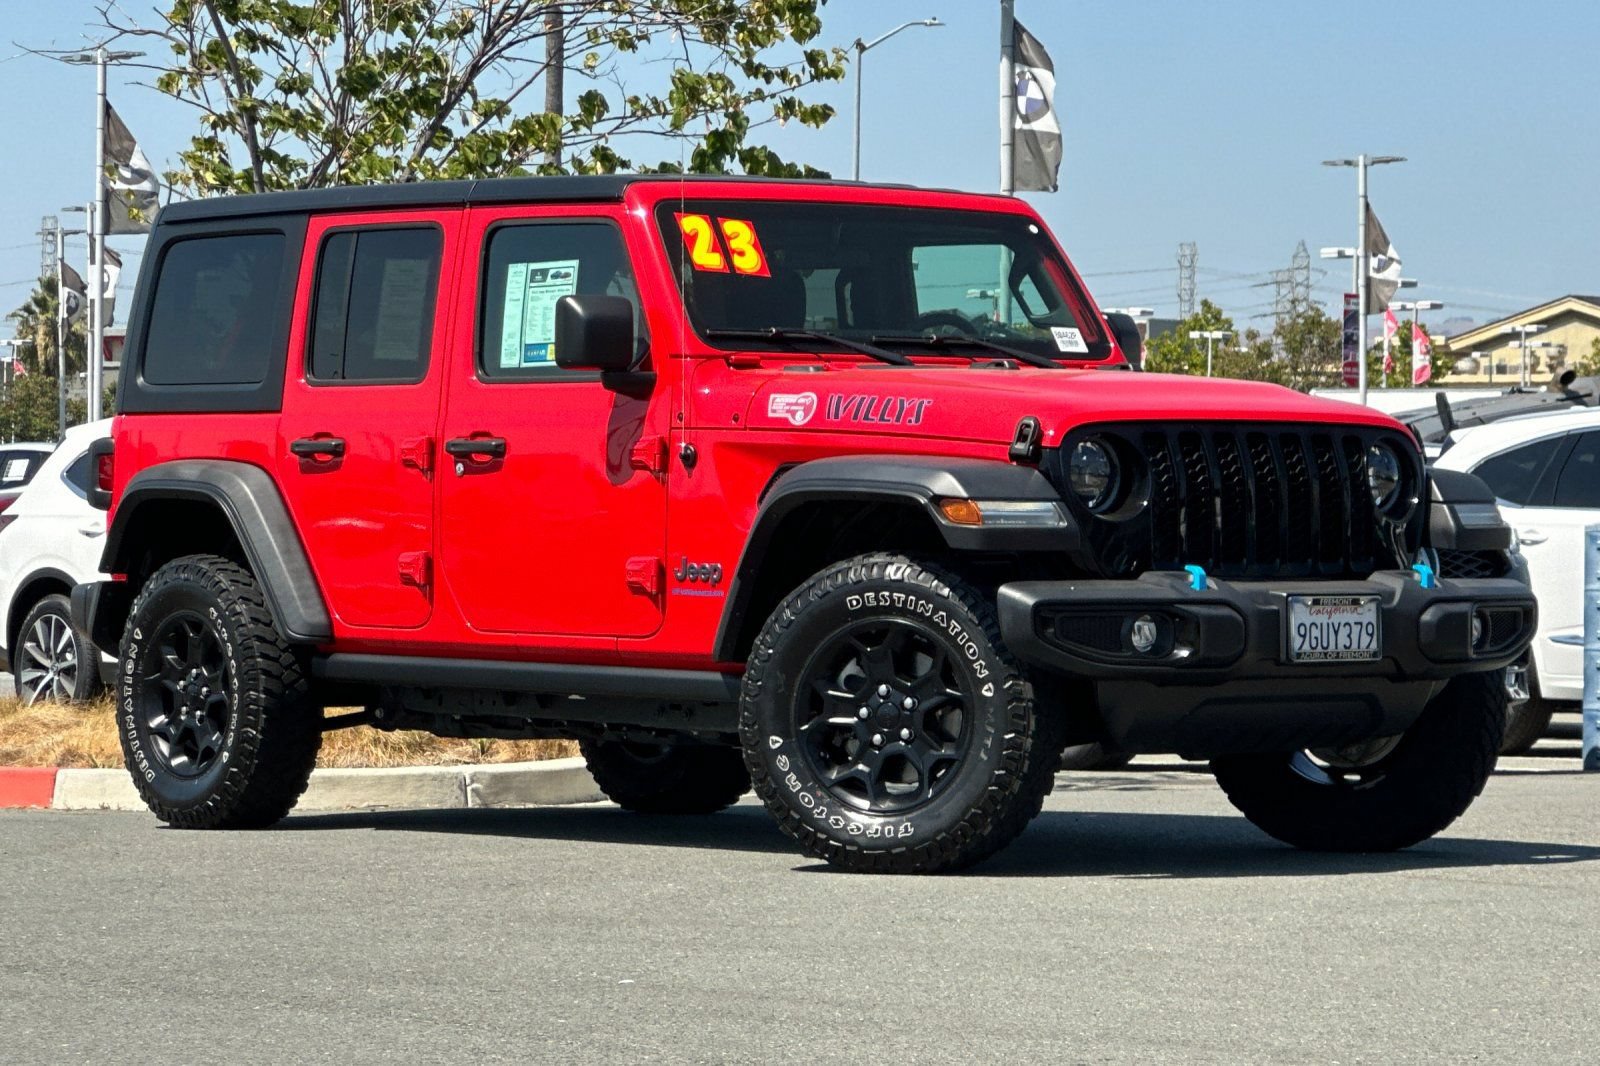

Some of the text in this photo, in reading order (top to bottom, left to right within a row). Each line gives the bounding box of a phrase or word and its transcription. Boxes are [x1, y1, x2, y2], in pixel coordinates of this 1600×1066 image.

[679, 214, 762, 271] 23
[826, 393, 933, 425] WILLYS
[674, 556, 722, 586] Jeep
[1319, 598, 1353, 606] FREMONT
[846, 591, 989, 679] DESTINATION
[1297, 621, 1375, 651] 9GUY379
[1300, 652, 1325, 660] ACURA
[1339, 651, 1373, 659] FREMONT
[124, 643, 155, 782] DESTINATION
